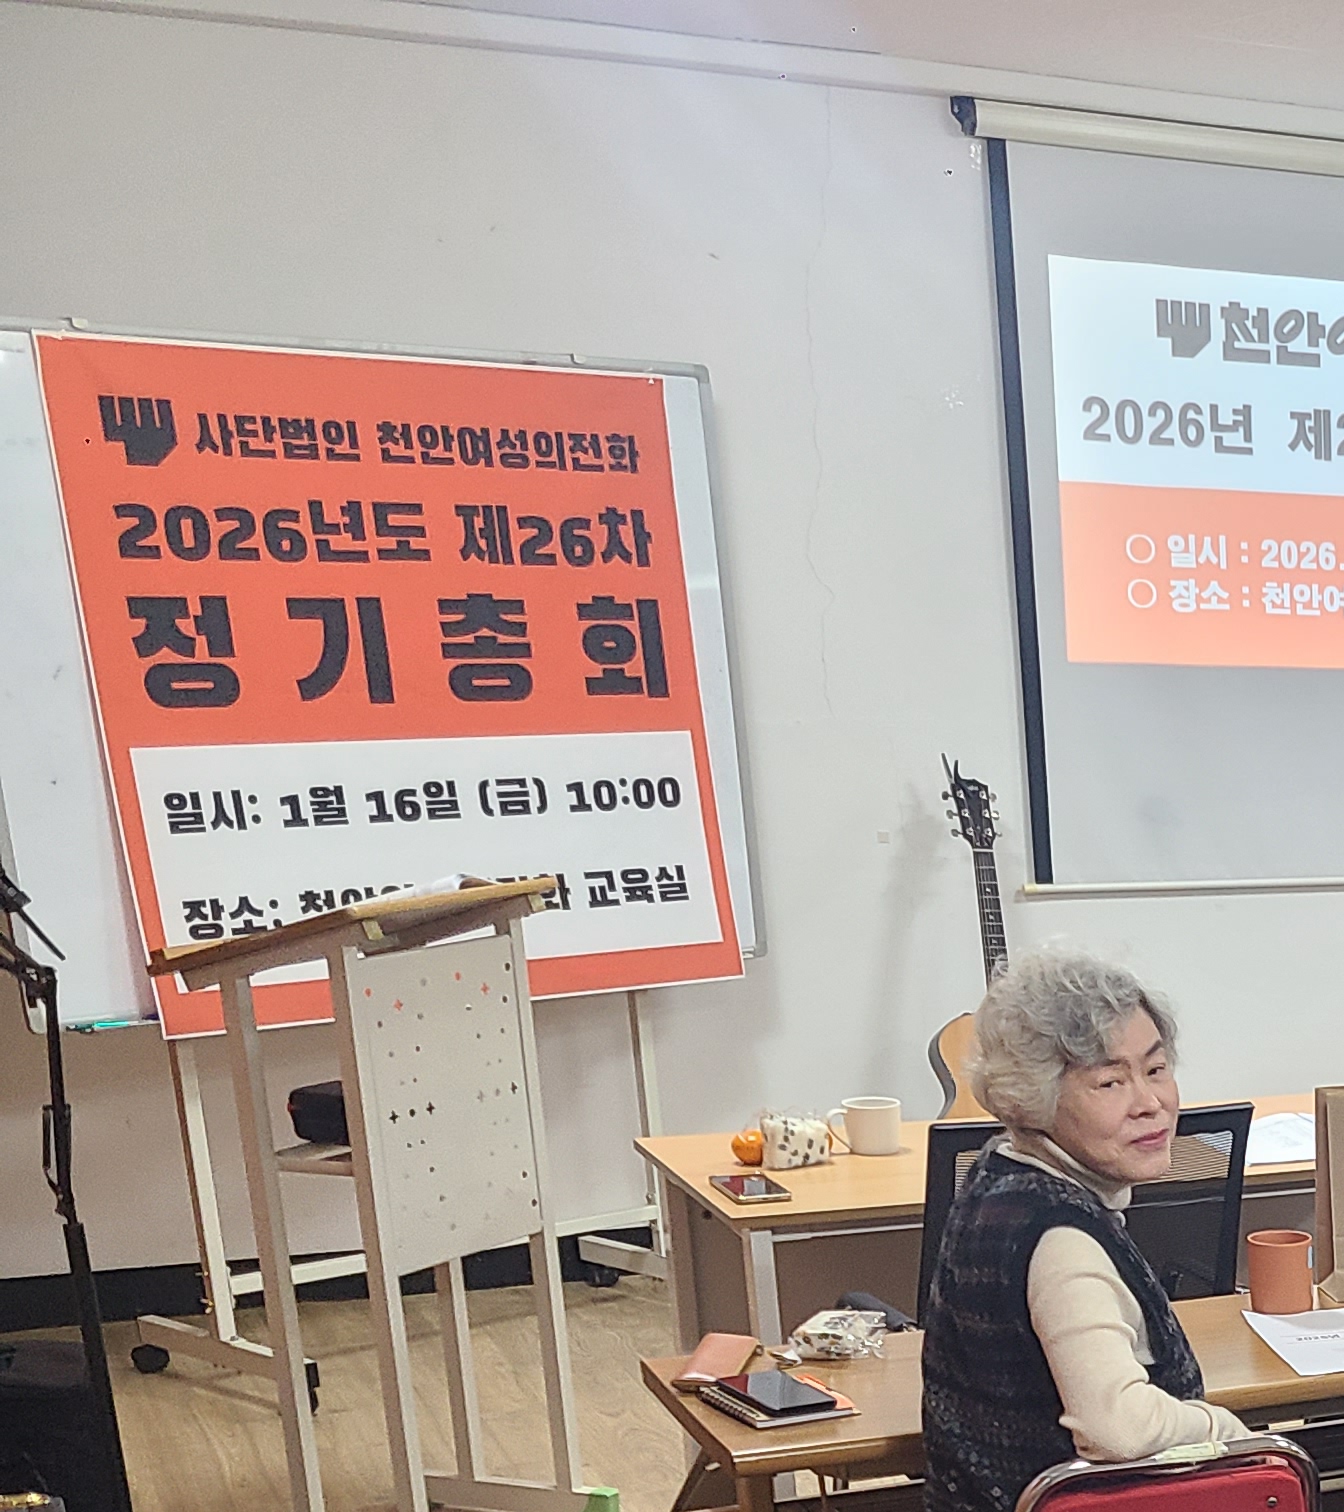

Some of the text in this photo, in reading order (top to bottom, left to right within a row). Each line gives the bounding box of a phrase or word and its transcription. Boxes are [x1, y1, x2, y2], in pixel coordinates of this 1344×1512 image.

[195, 411, 641, 475] 사단법인 천안여성의전화
[1081, 395, 1254, 456] 2026년
[112, 500, 652, 568] 2026년도 제26차
[1167, 534, 1228, 570] 일시
[1168, 579, 1230, 614] 장소
[162, 776, 682, 835] 일시: 1월 16일 (금) 10:00
[182, 897, 281, 943] 장소:
[583, 864, 690, 909] 교육실
